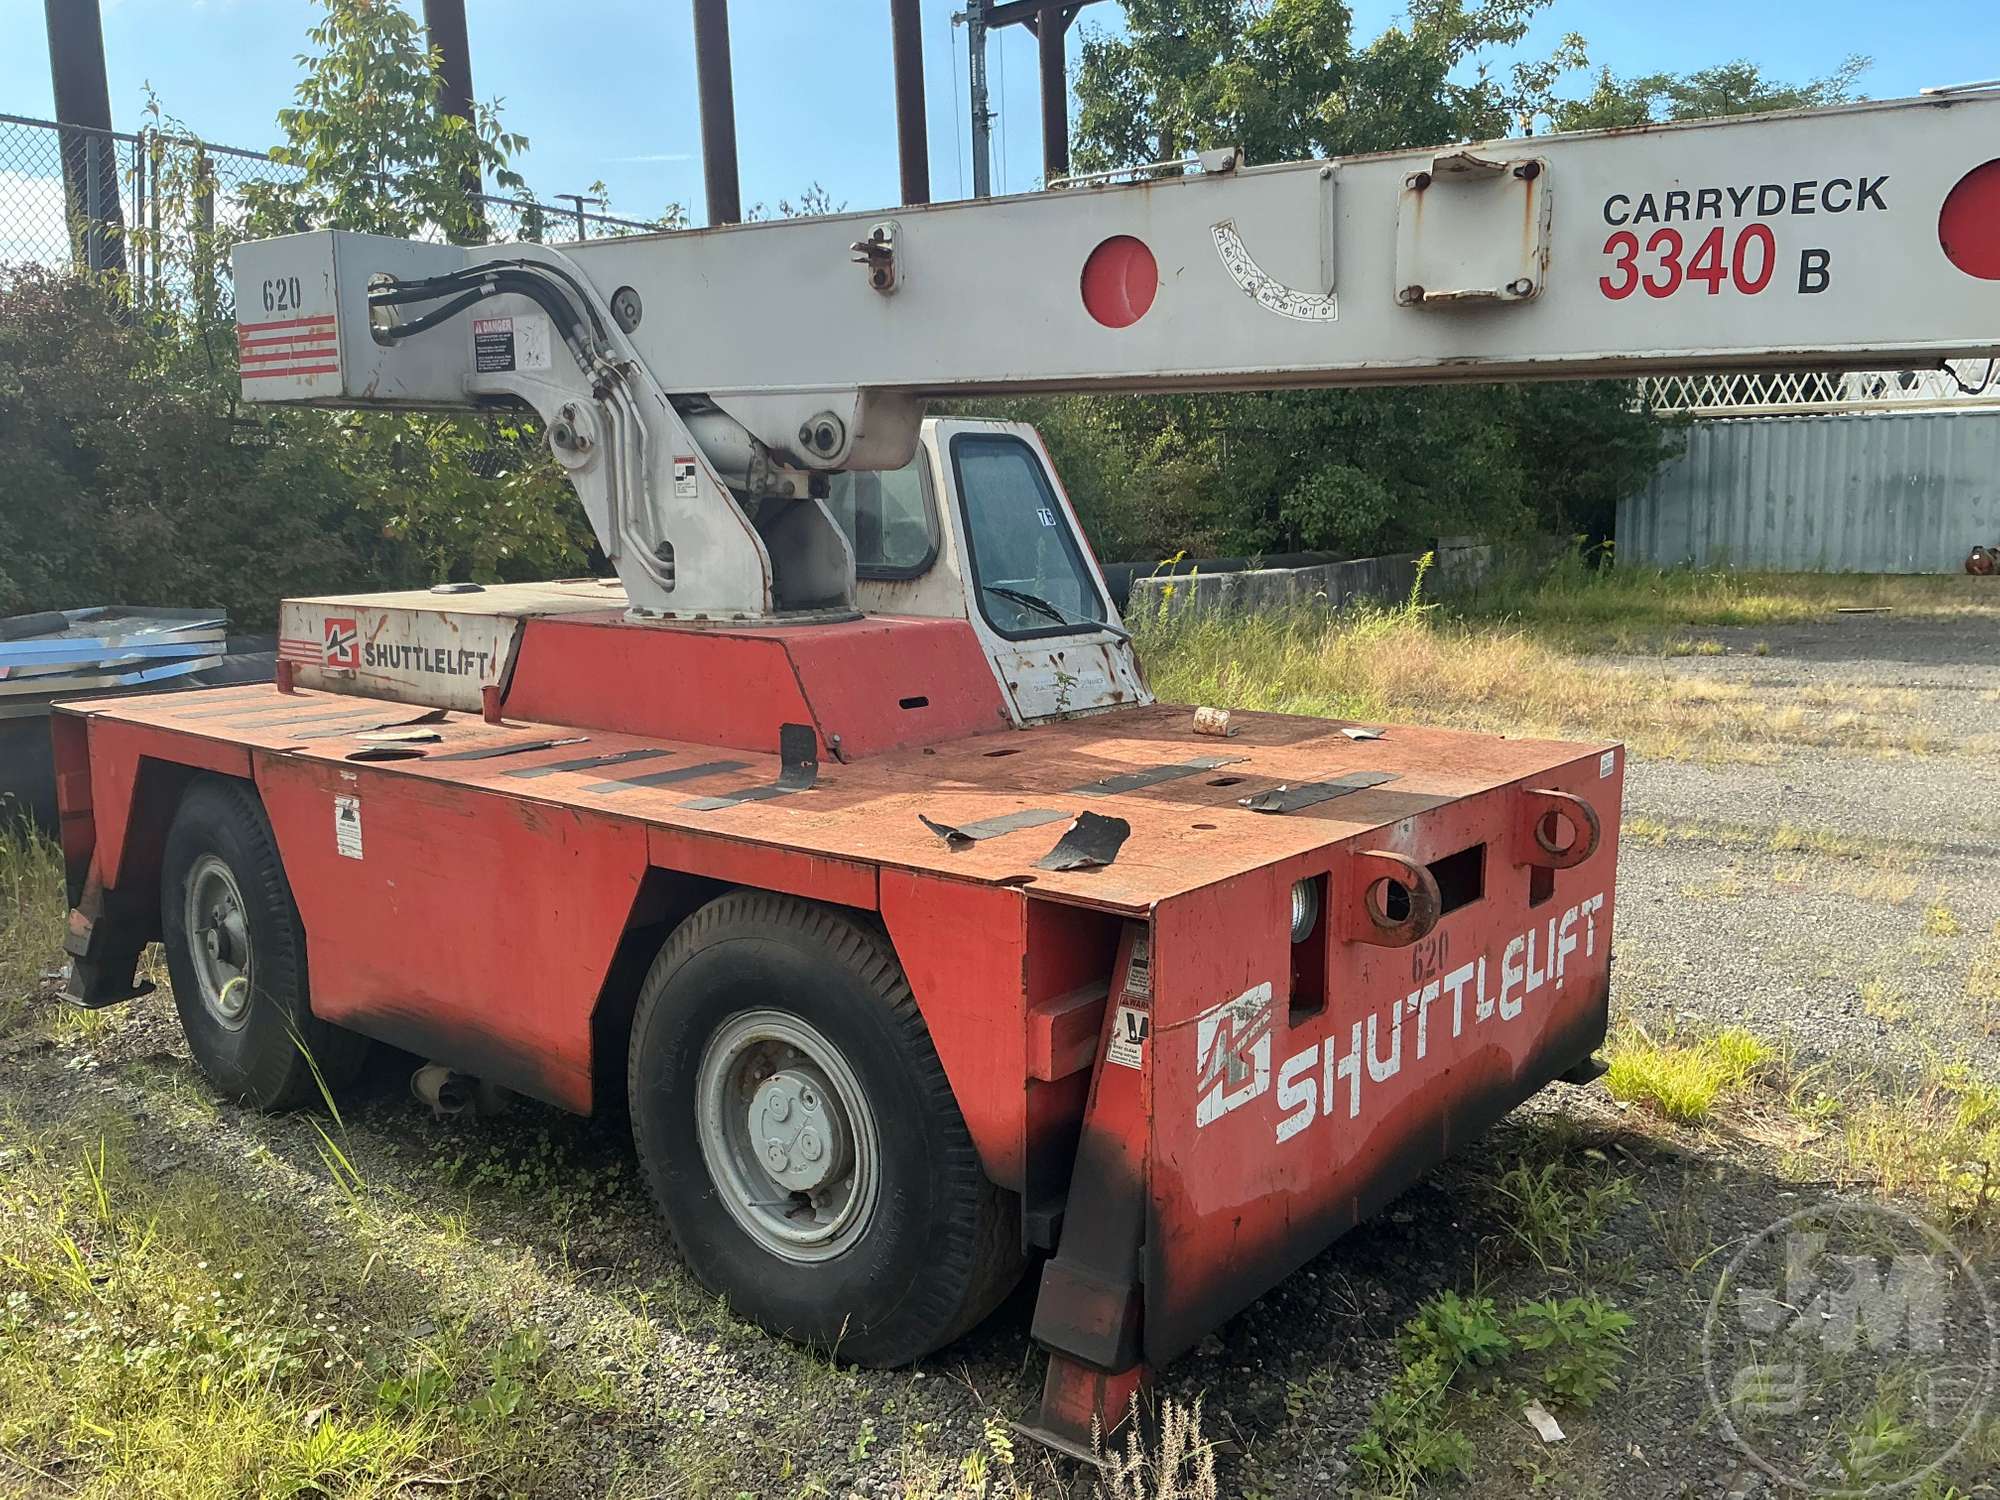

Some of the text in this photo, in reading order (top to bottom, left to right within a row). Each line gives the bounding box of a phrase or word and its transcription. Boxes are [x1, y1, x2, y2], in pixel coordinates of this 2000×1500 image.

[1603, 175, 1890, 226] CARRYDECK
[1599, 223, 1831, 300] 3340 B
[262, 276, 301, 312] 620
[483, 319, 511, 333] DANGER
[364, 642, 488, 680] SHUTTLELIFT
[1412, 929, 1449, 984] 620
[1276, 892, 1603, 1144] SHUTTLELIFT
